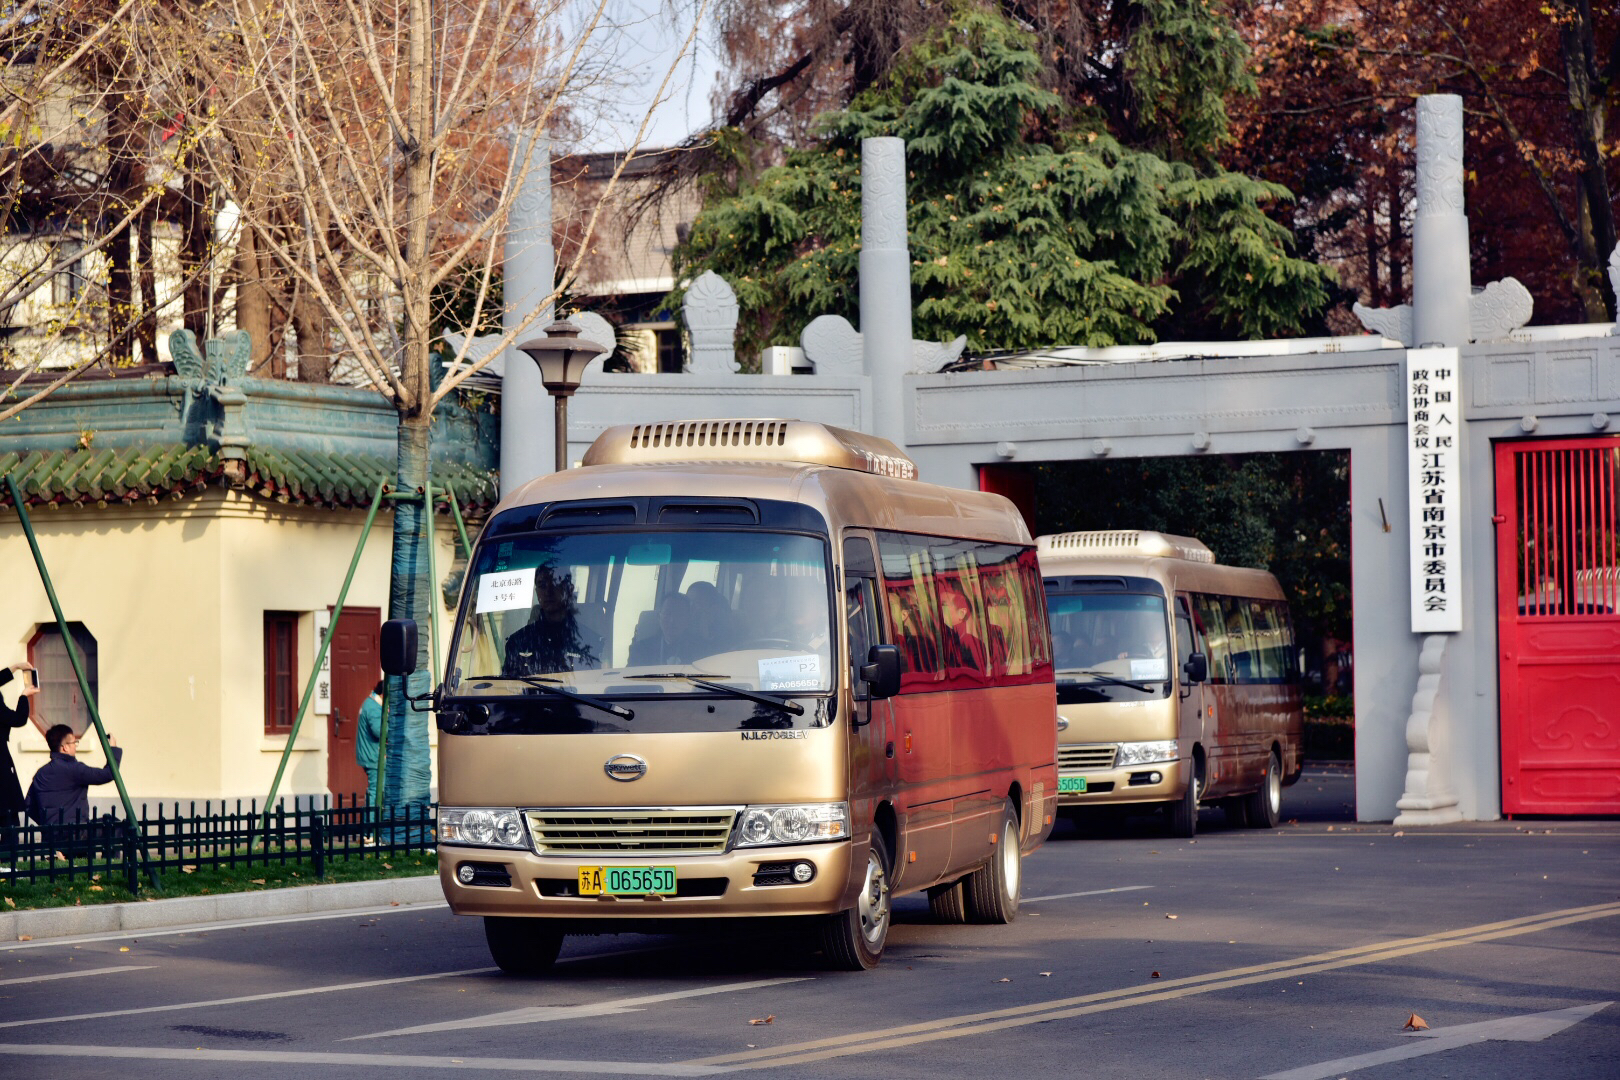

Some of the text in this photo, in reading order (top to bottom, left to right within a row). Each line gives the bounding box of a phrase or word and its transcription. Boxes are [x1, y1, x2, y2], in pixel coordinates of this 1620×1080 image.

[1412, 369, 1430, 449] 政治协商会议
[1435, 368, 1452, 448] 中国人民
[1421, 453, 1447, 612] 江苏省南京市委员会
